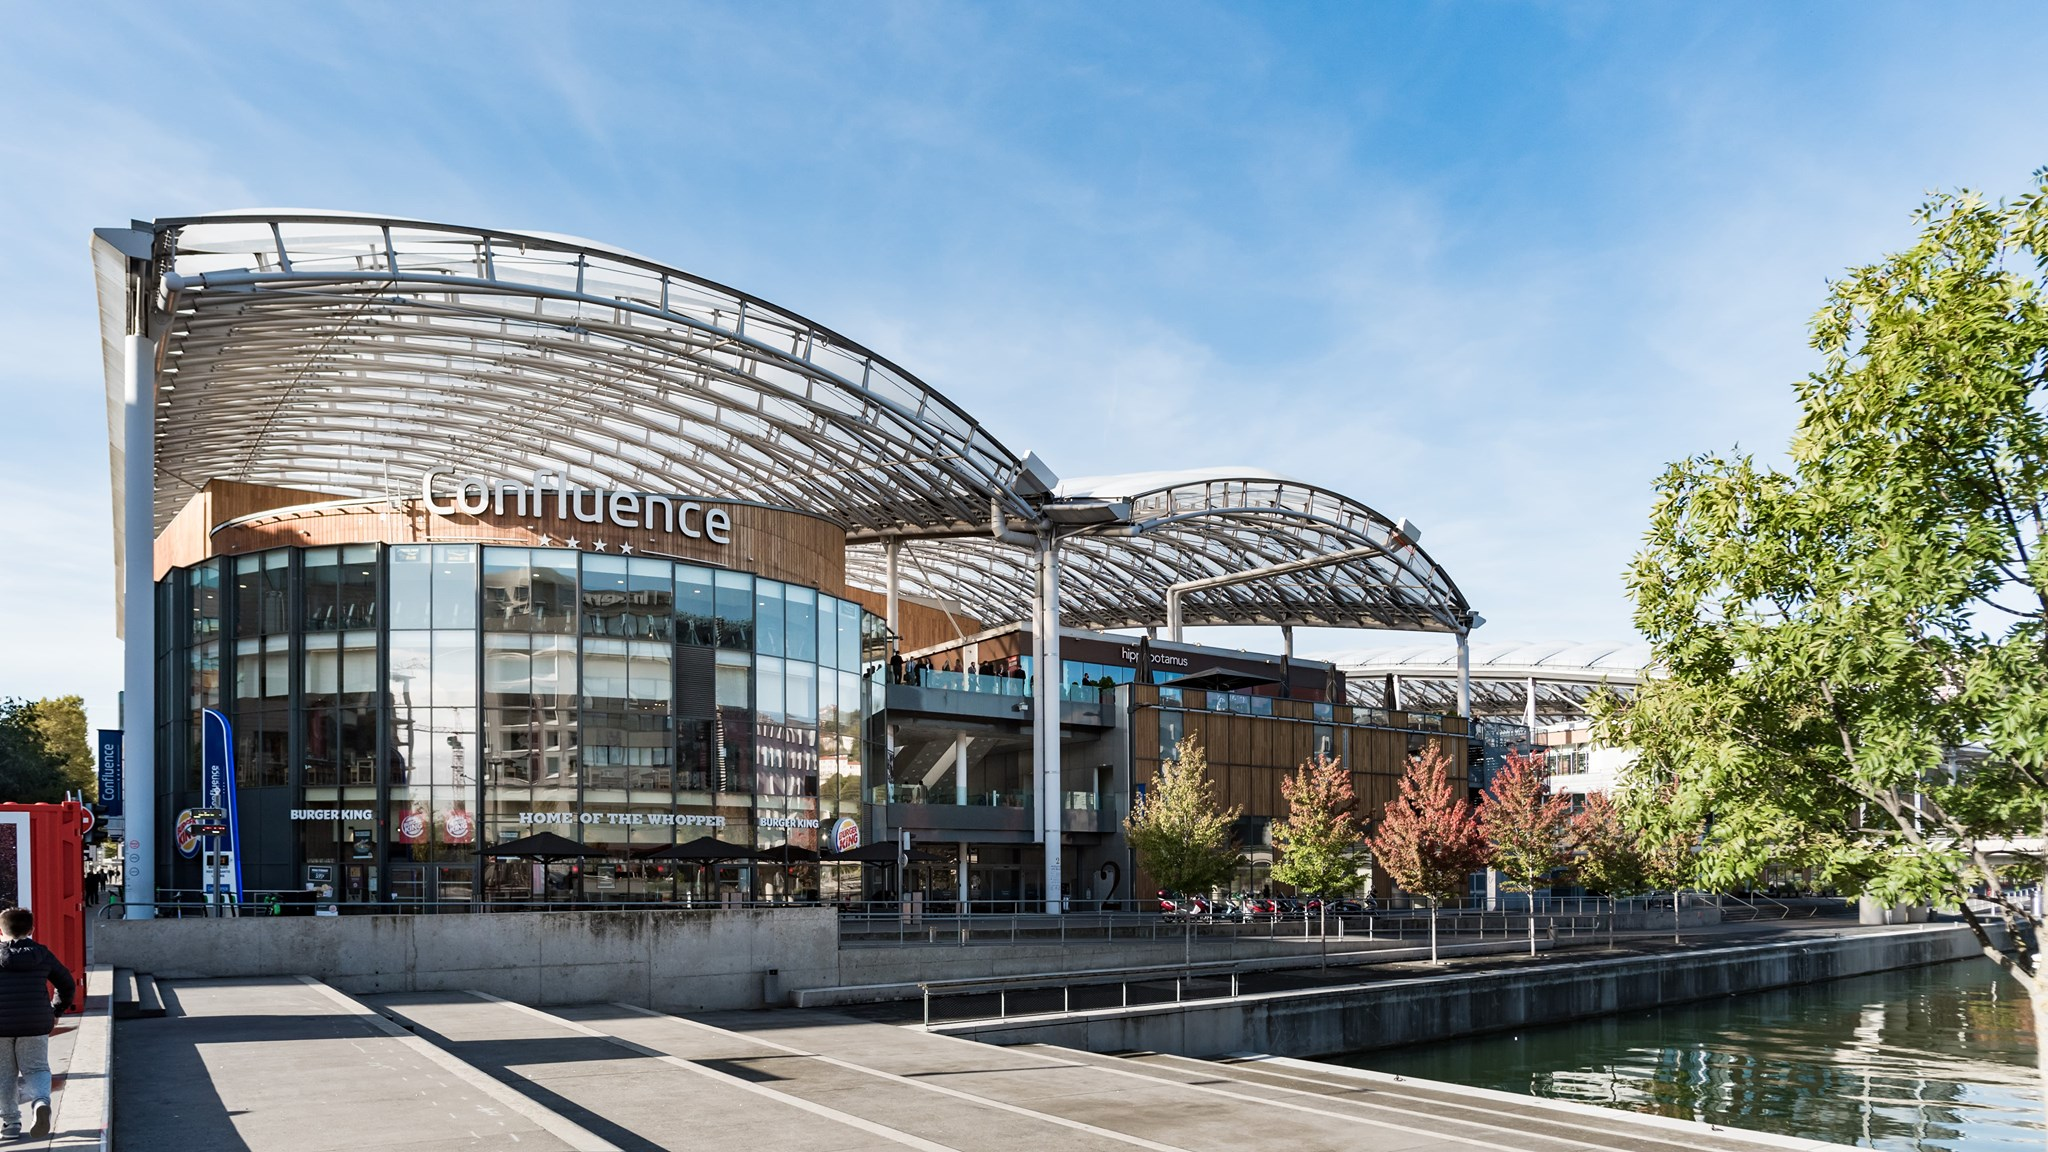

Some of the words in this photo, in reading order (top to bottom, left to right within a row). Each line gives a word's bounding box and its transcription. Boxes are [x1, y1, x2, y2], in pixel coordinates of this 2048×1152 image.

[422, 466, 731, 544] Confluence
[1121, 646, 1188, 667] hippotamus
[102, 743, 115, 801] Confluence
[290, 809, 339, 820] BURGER
[341, 809, 373, 820] KING
[519, 812, 573, 824] HOME
[579, 812, 604, 824] OF
[607, 813, 643, 825] THE
[647, 814, 726, 827] WHOPPER
[760, 817, 796, 828] BURGER
[797, 819, 819, 829] KING
[838, 825, 858, 840] BURGER
[839, 833, 858, 851] KING
[1101, 860, 1121, 911] 2
